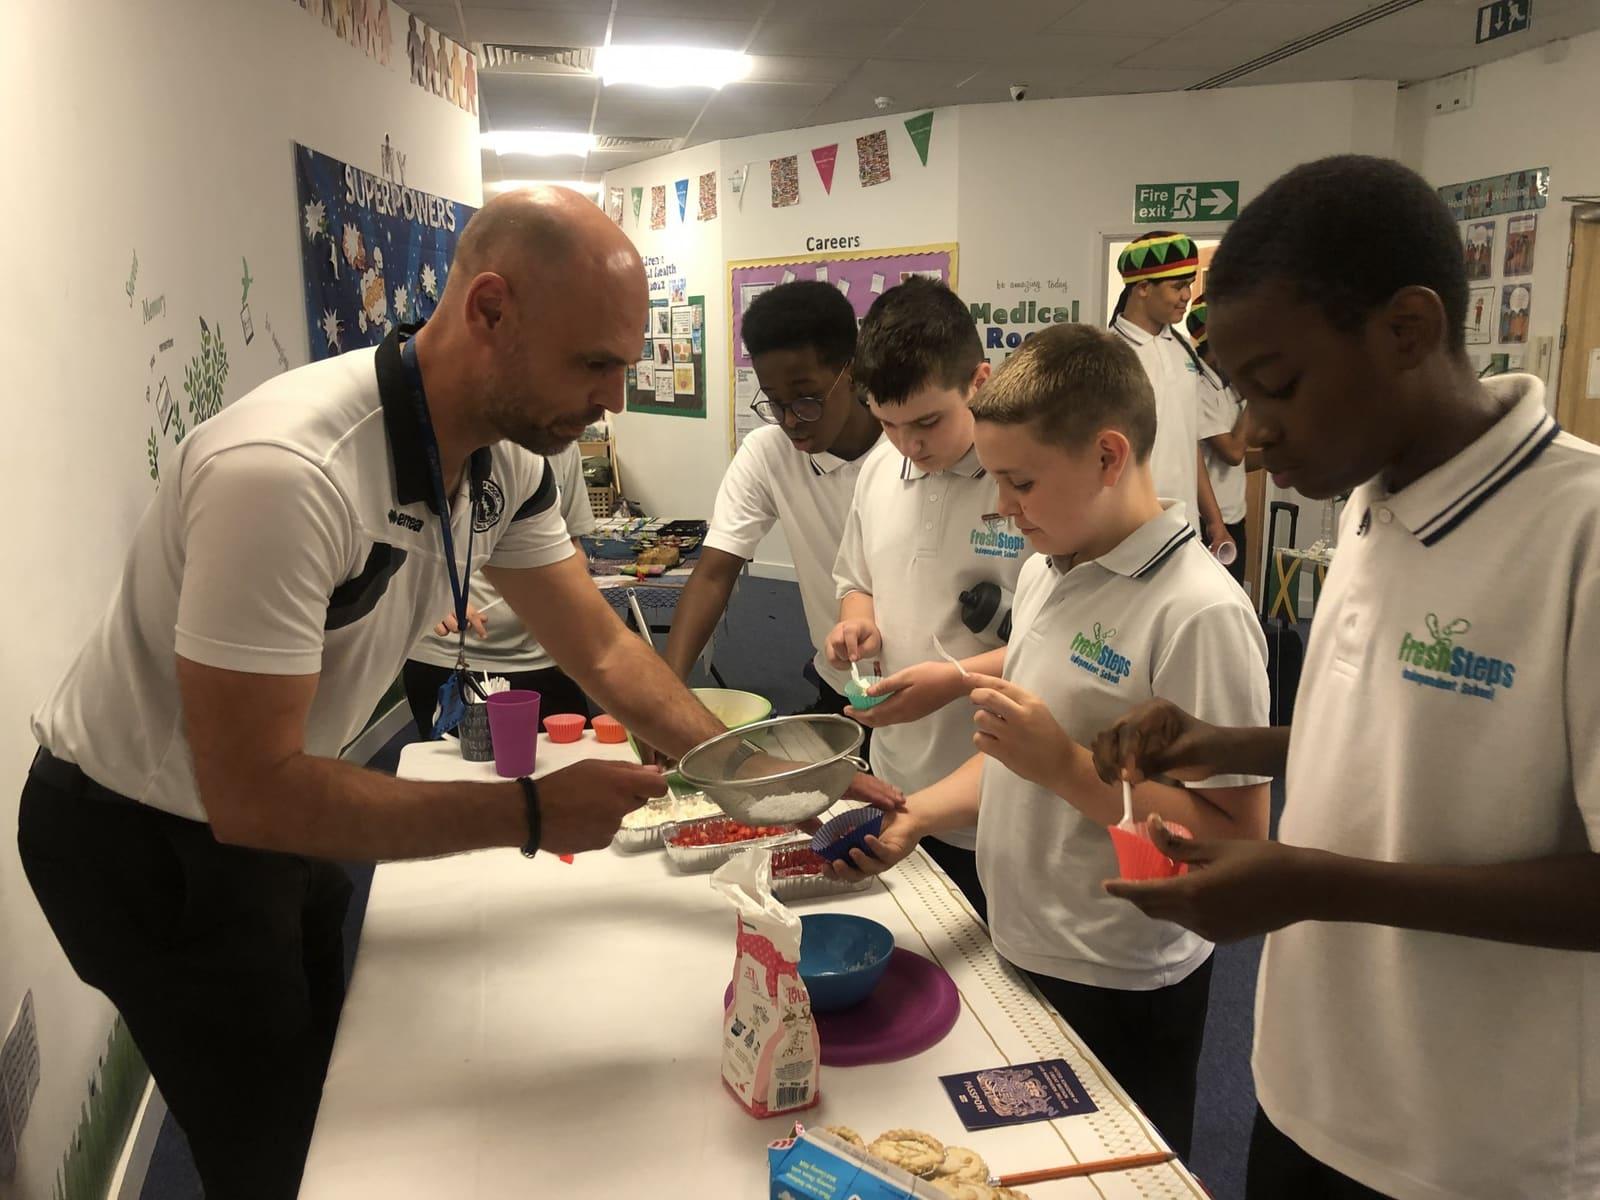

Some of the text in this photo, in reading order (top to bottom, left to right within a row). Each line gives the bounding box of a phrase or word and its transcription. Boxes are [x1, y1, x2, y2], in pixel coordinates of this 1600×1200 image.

[345, 164, 457, 233] SUPERPOWERS
[1140, 188, 1169, 203] Fire
[1138, 204, 1167, 218] exit
[806, 234, 861, 252] Careers
[1047, 277, 1068, 293] today
[970, 300, 1080, 325] Medical
[986, 327, 1036, 349] Ro
[963, 1080, 988, 1113] PASSPORT
